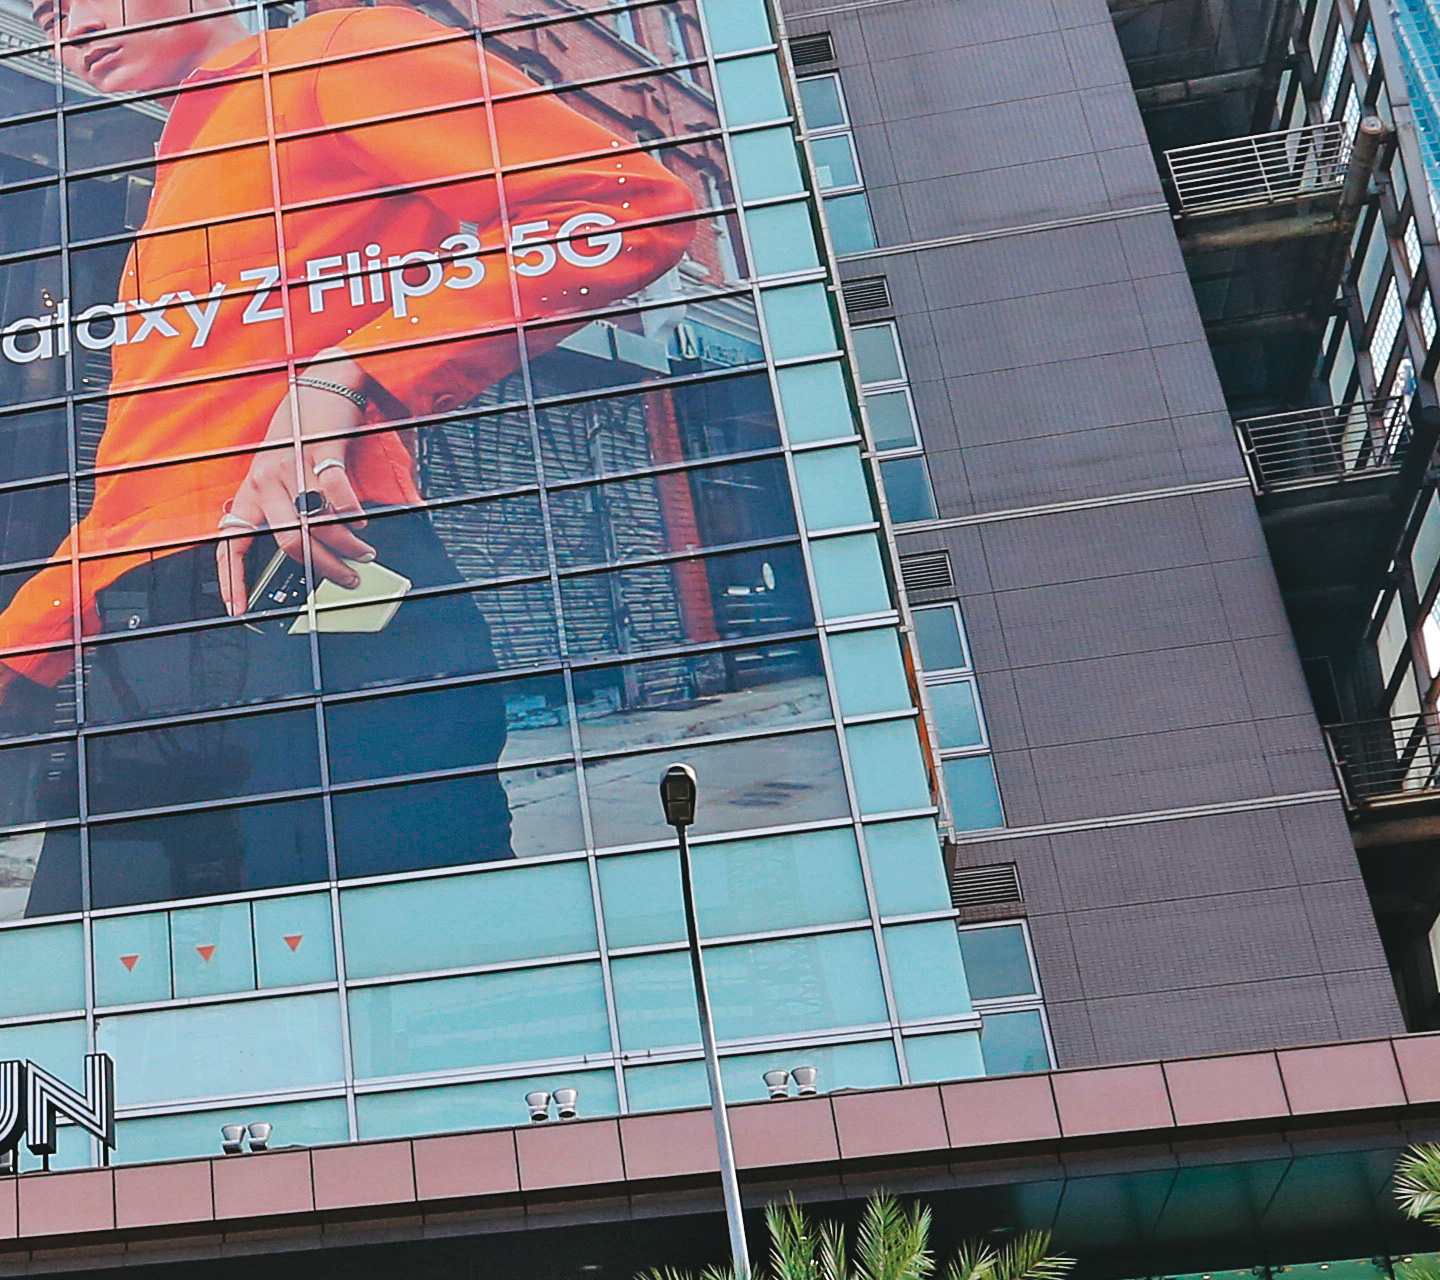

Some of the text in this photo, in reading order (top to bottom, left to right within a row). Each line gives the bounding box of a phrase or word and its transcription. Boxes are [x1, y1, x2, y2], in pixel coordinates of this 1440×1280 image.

[239, 266, 286, 326] Z
[306, 234, 488, 319] Flip3
[510, 211, 624, 278] 5G
